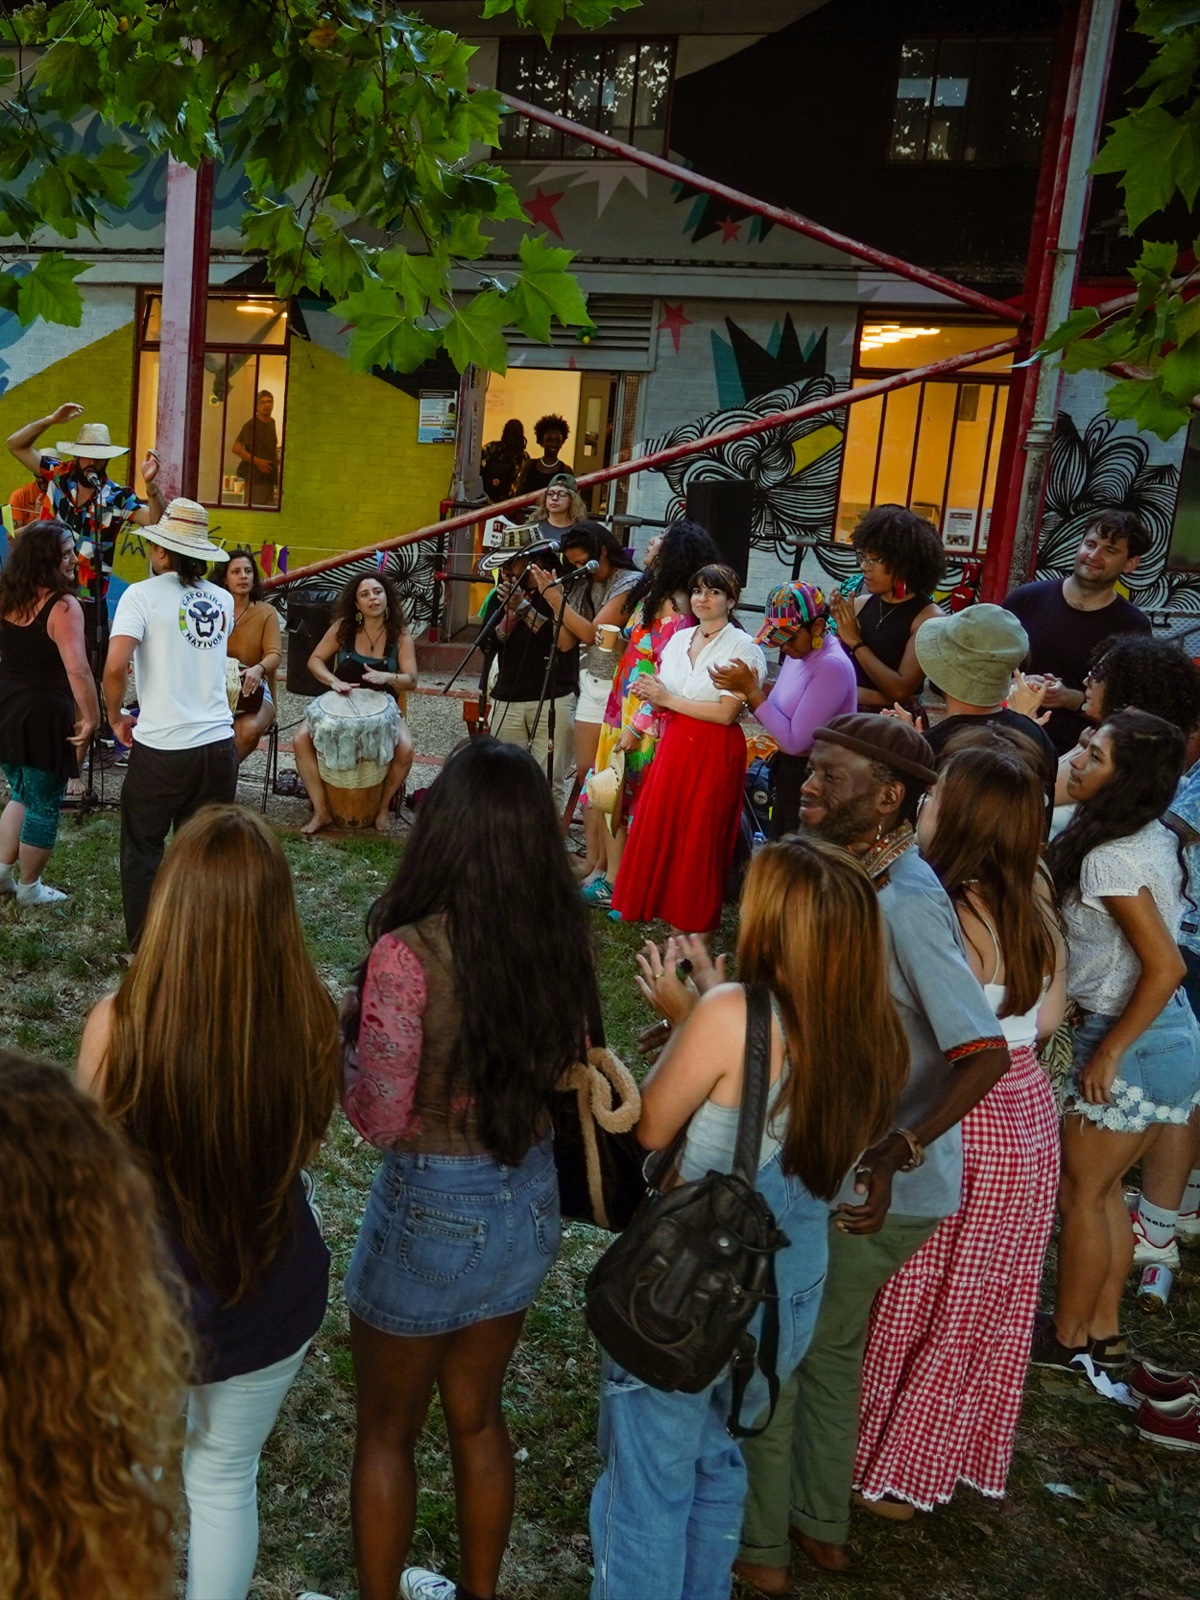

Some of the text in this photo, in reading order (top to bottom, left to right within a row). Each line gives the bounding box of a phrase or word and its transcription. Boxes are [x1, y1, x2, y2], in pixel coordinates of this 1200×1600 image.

[182, 592, 223, 609] CAPOEIRA
[186, 633, 222, 648] NATIVOS
[1140, 1211, 1176, 1228] Reebok
